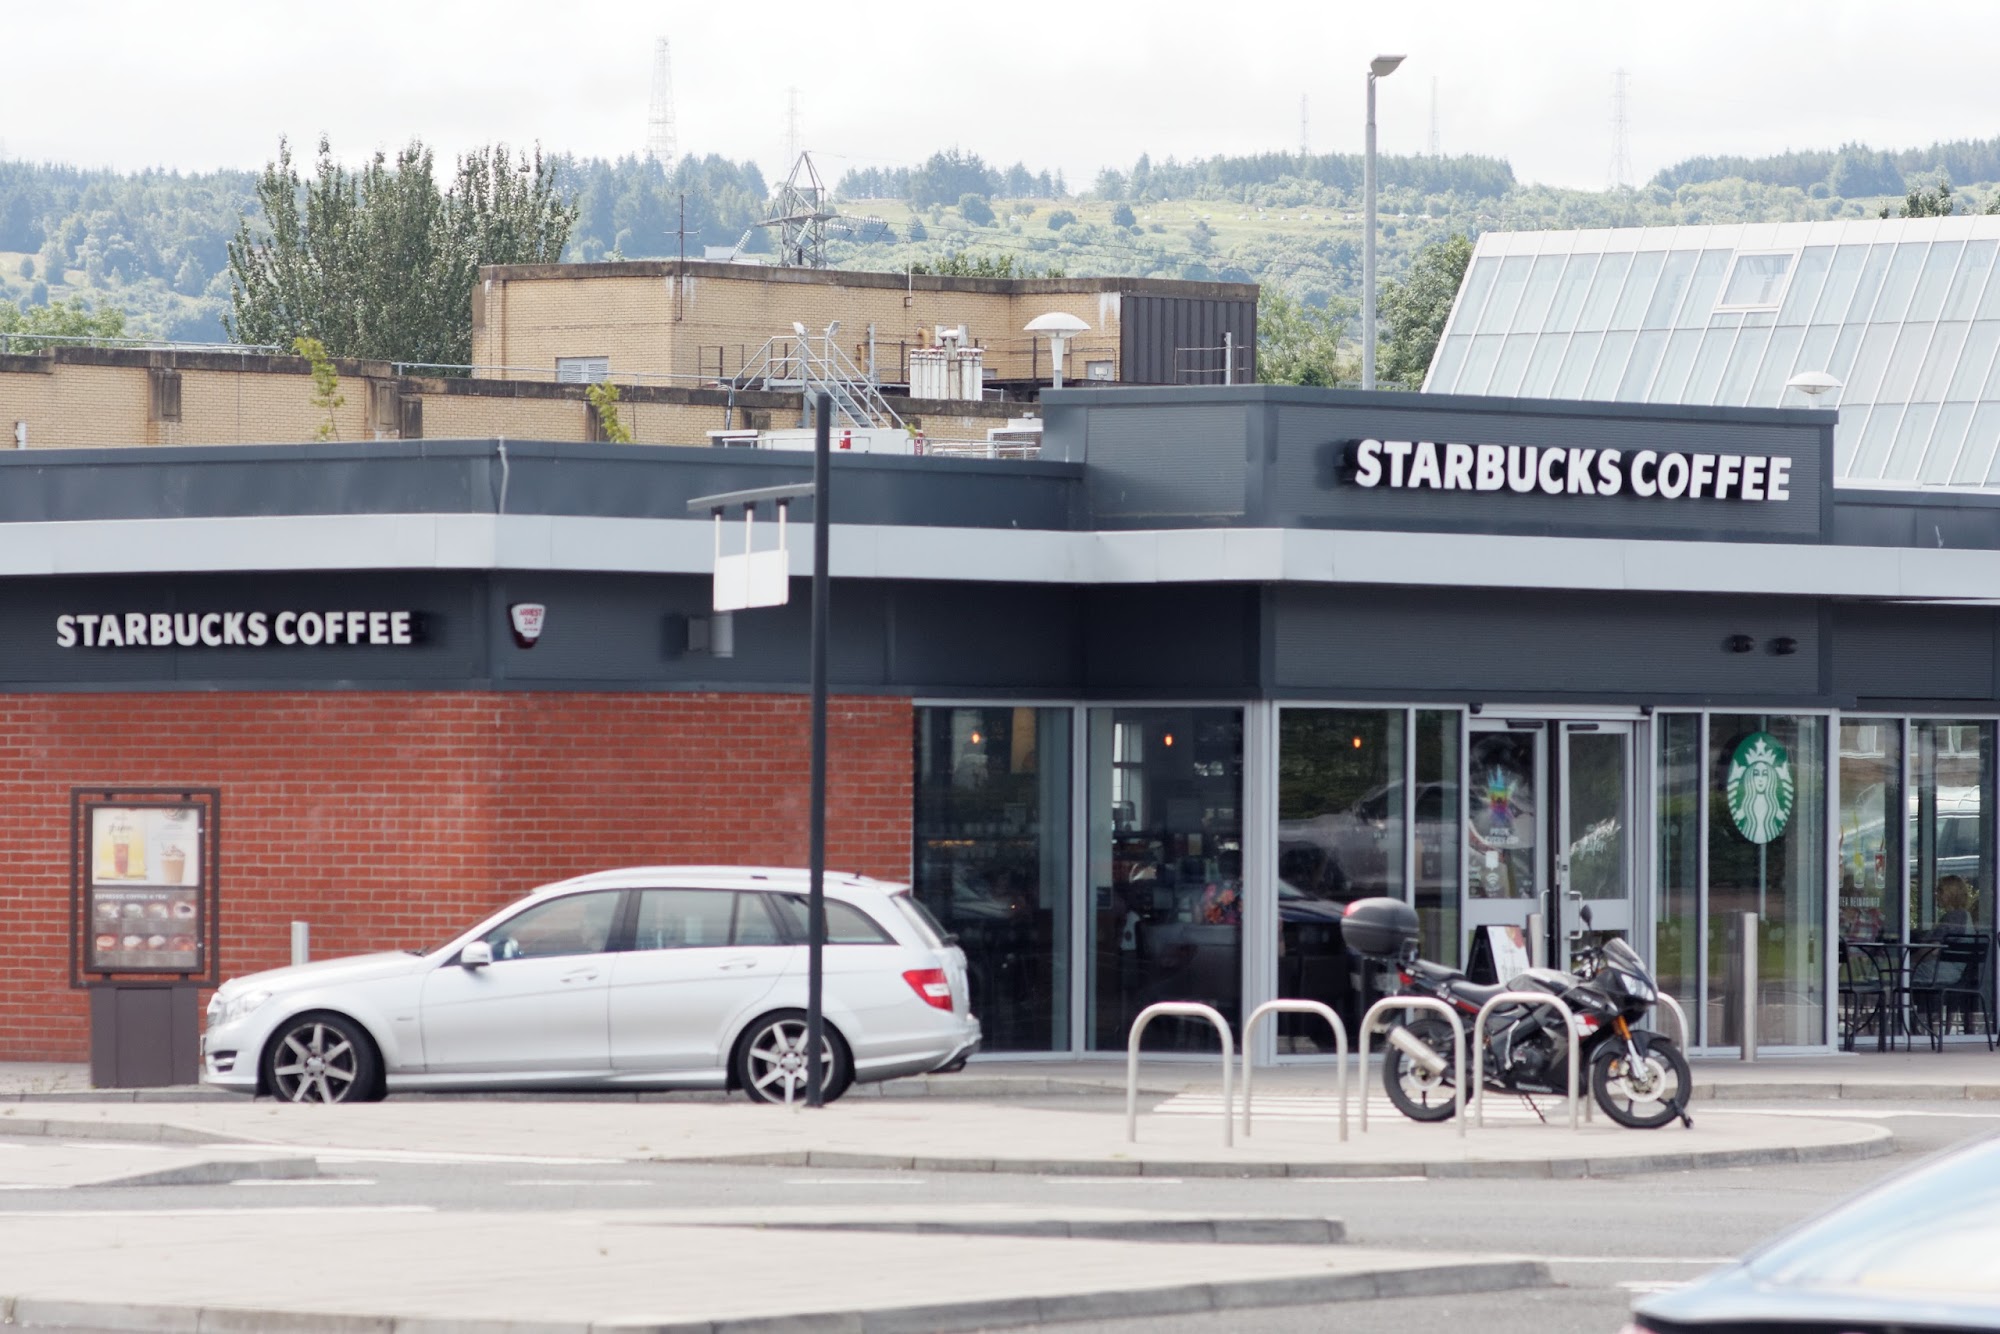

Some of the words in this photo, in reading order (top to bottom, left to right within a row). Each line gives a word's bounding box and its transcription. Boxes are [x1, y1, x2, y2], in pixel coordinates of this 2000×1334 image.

[1355, 439, 1623, 496] STARBUCKS
[1630, 450, 1792, 501] COFFEE
[56, 612, 268, 648] STARBUCKS
[274, 611, 412, 646] COFFEE
